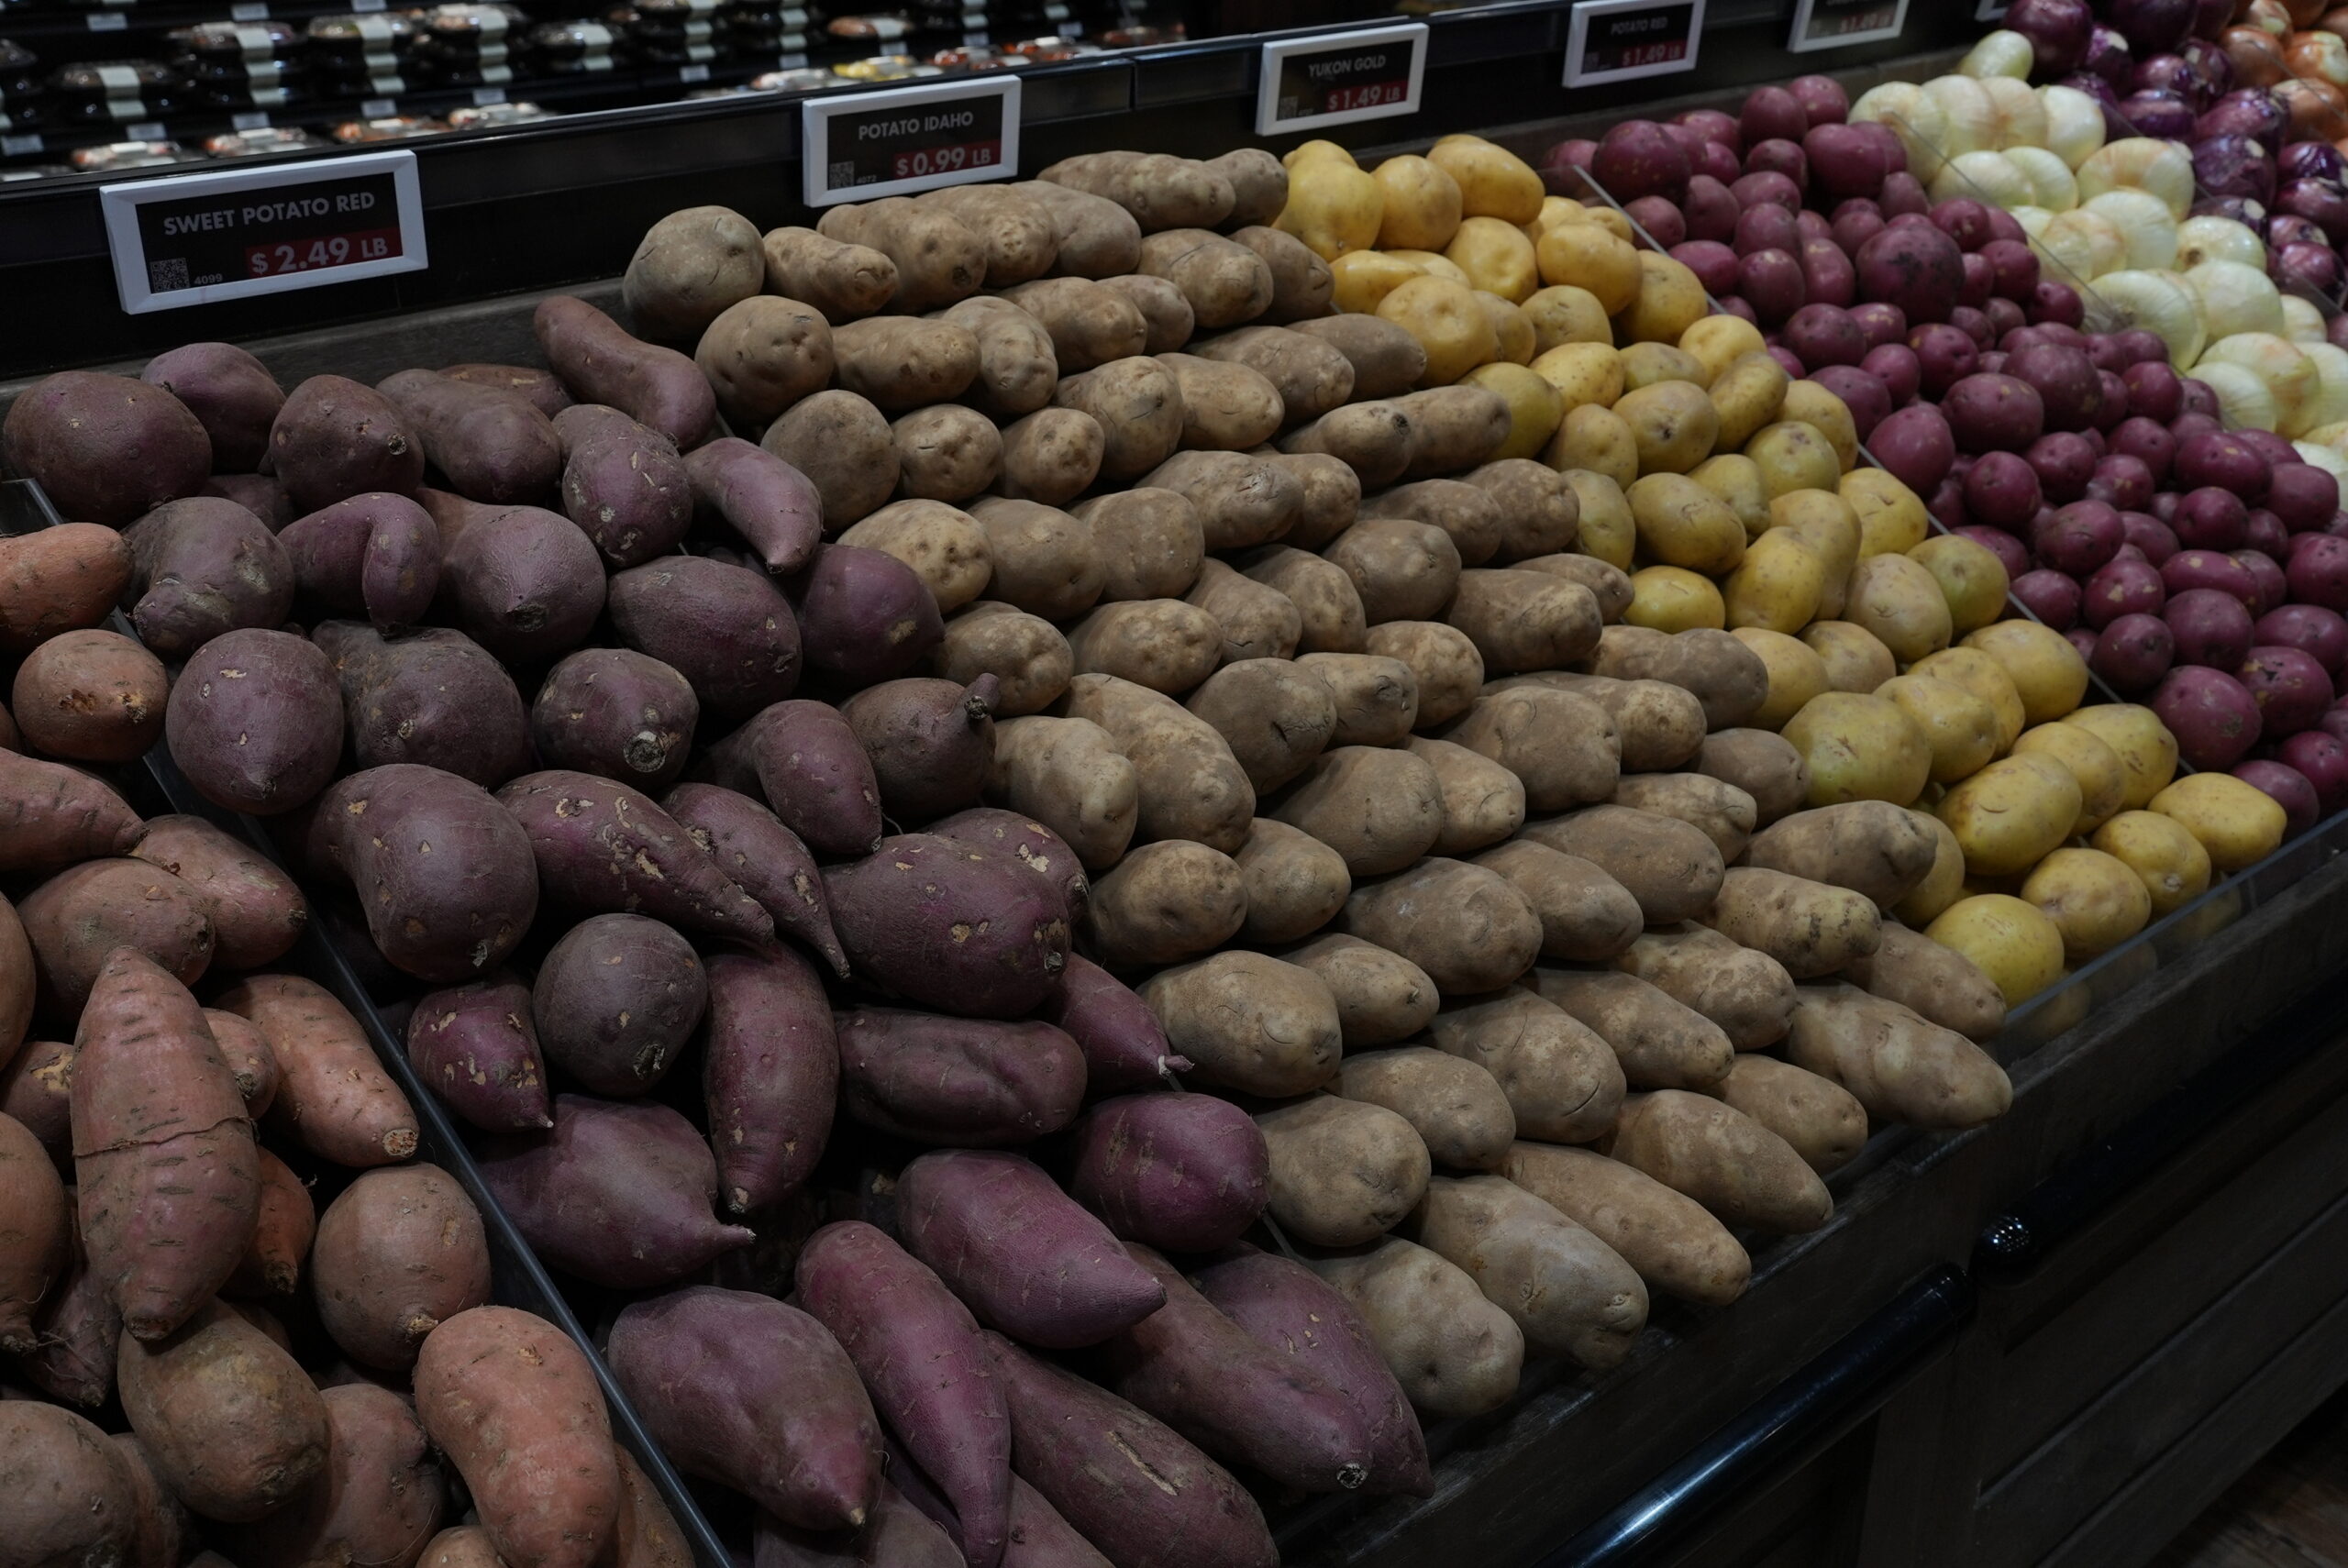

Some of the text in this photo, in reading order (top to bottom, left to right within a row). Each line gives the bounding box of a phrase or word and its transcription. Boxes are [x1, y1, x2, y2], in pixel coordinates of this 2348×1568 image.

[1611, 17, 1668, 36] POTATO RED
[1668, 45, 1680, 60] LB
[1308, 54, 1387, 77] YUKON GOLD
[1385, 86, 1401, 102] LB
[858, 111, 974, 140] POTATO IDAHO
[972, 149, 991, 166] LB
[163, 191, 376, 236] SWEET POTATO RED
[361, 237, 389, 259] LB
[194, 272, 224, 286] 4099
